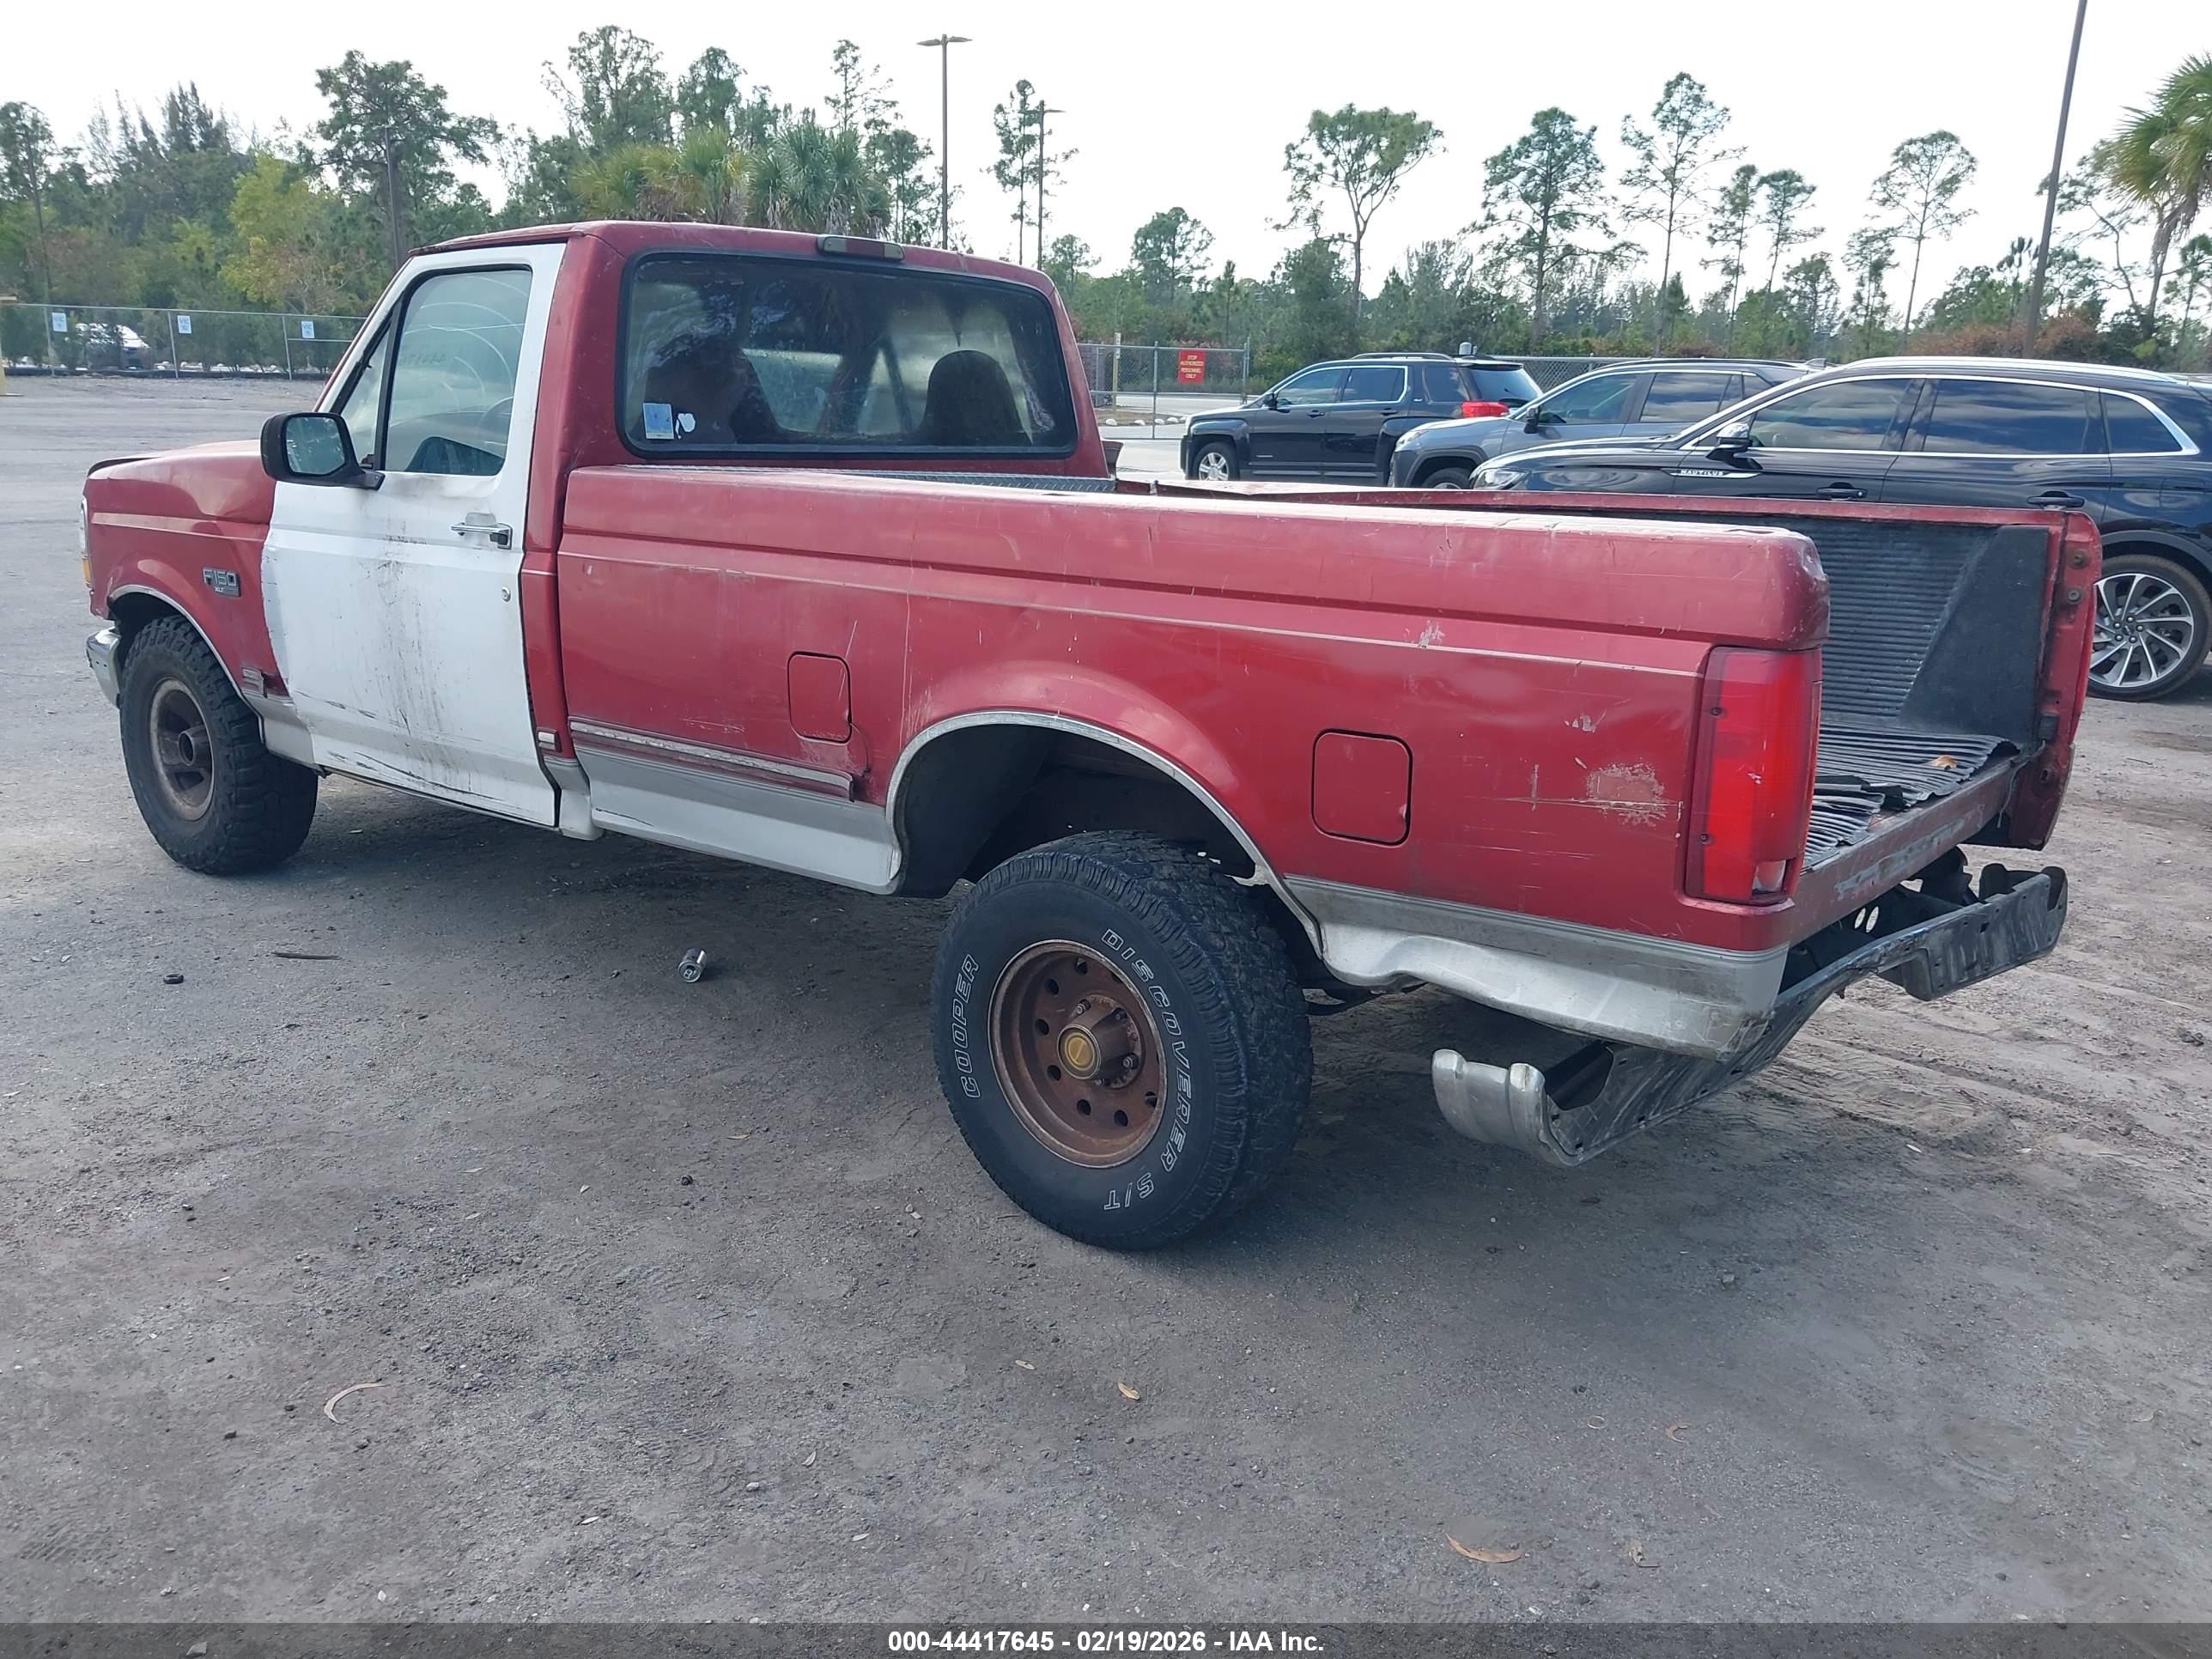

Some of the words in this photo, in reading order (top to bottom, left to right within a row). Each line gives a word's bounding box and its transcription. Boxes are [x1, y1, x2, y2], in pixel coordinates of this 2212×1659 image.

[951, 954, 981, 1098] COOPER
[1101, 928, 1192, 1172] DISCOVERER
[1103, 1172, 1155, 1210] S/T
